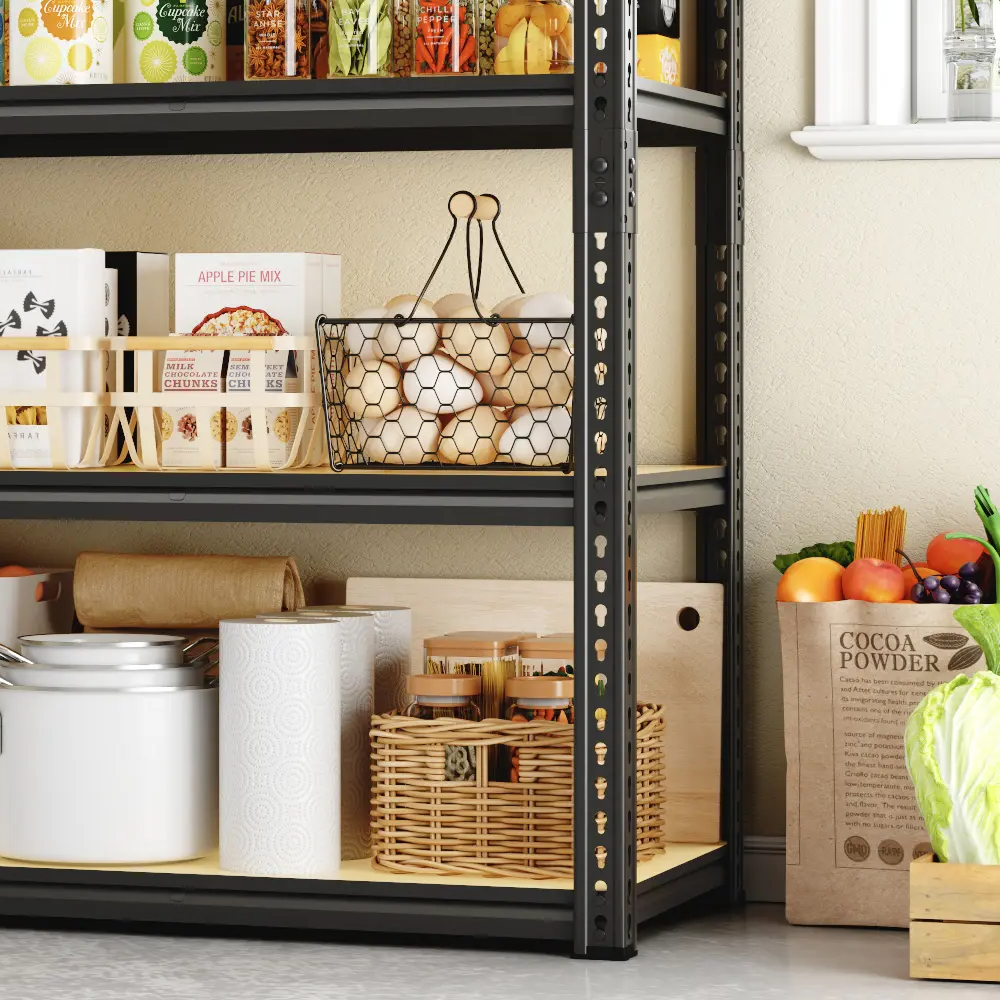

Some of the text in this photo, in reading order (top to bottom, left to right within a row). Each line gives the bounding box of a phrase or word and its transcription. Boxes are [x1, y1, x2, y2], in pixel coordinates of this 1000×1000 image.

[43, 0, 91, 16] Cupcake
[159, 3, 206, 20] Cupcake
[256, 10, 281, 18] STAR
[56, 13, 85, 29] Mix
[172, 17, 202, 33] Mix
[253, 20, 283, 28] ANISE
[417, 15, 457, 24] PEPPER
[198, 270, 281, 283] APPLE PIE MIX
[164, 379, 218, 388] CHUNKS
[839, 631, 916, 651] COCOA
[839, 651, 940, 672] POWDER
[853, 686, 870, 694] Aztec
